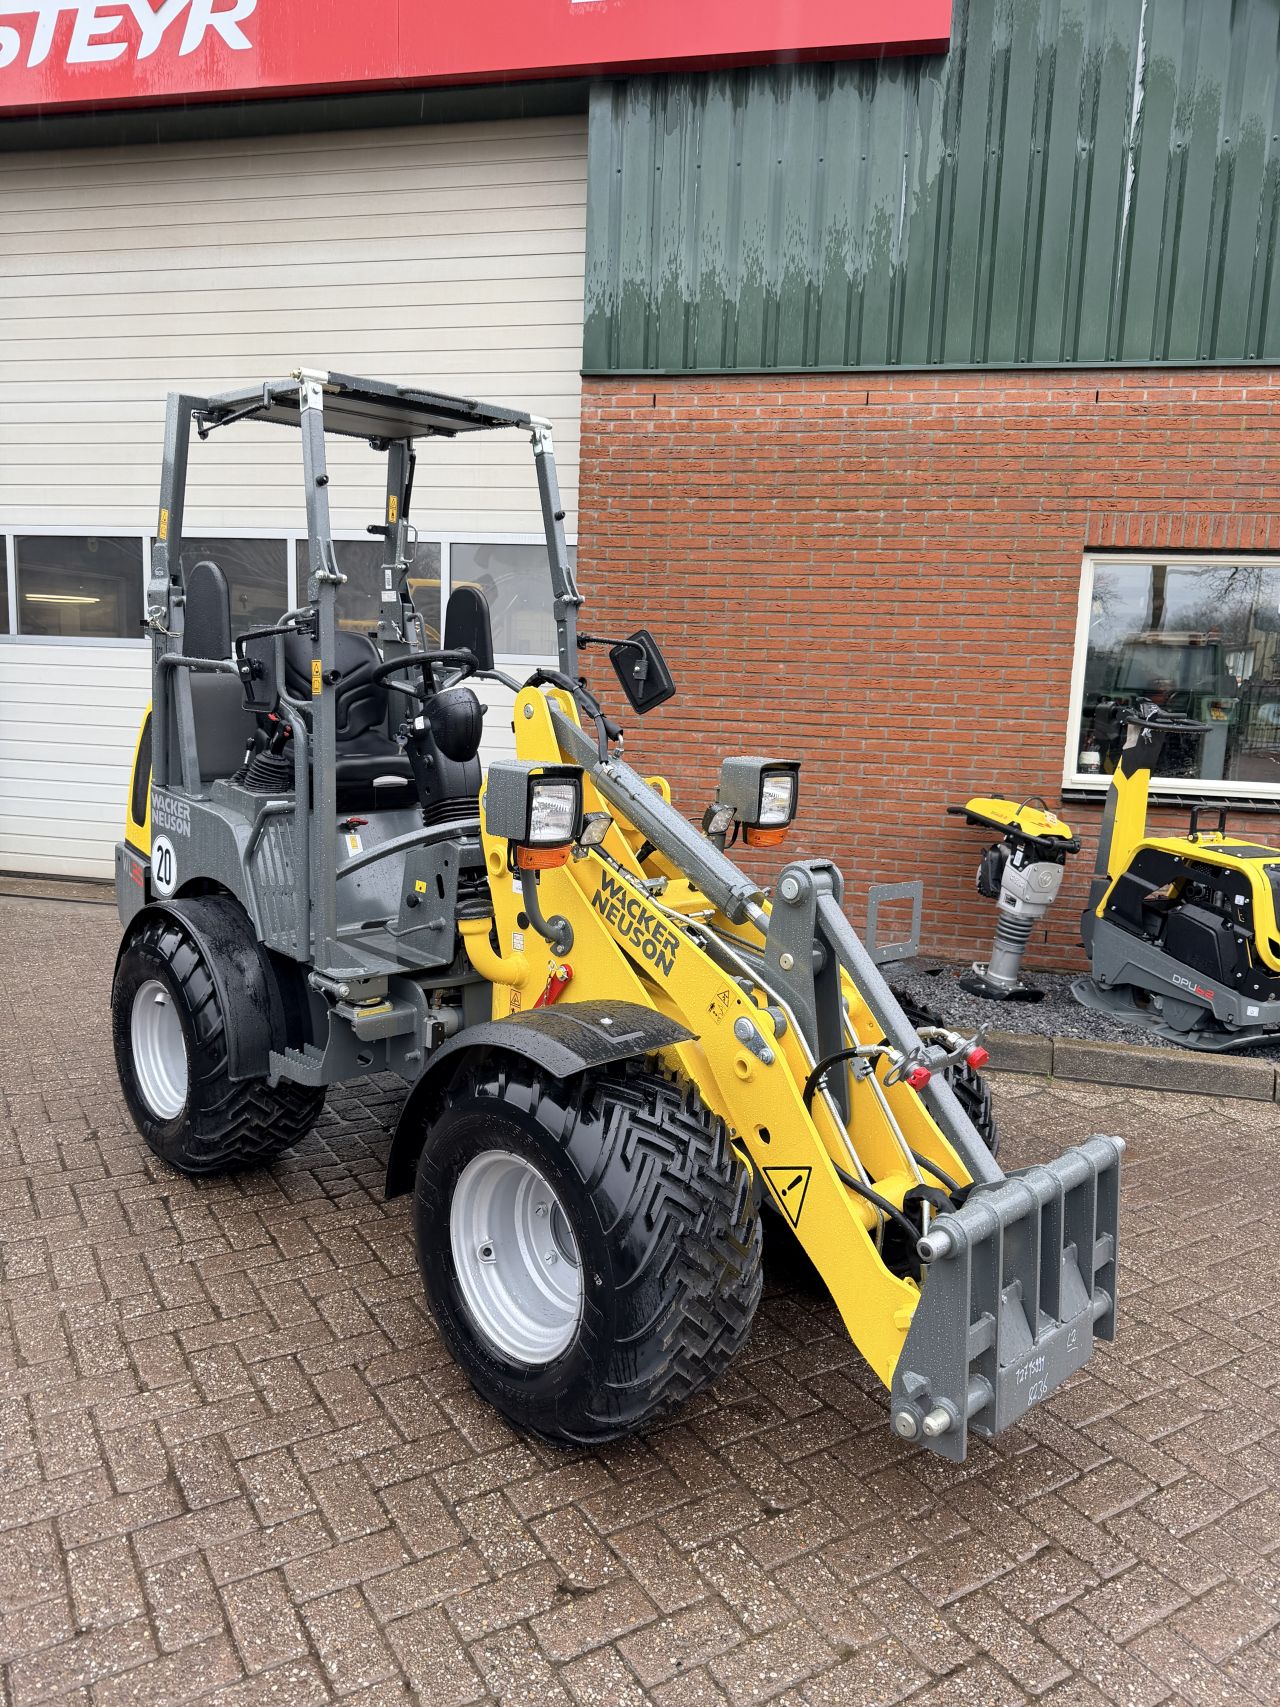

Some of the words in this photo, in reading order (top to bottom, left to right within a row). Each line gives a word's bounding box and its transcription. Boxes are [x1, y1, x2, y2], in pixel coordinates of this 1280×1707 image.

[151, 792, 191, 821] WACKER
[151, 808, 191, 837] NEUSON
[157, 845, 172, 886] 20
[591, 888, 675, 977] NEUSON
[601, 869, 680, 959] WACKER
